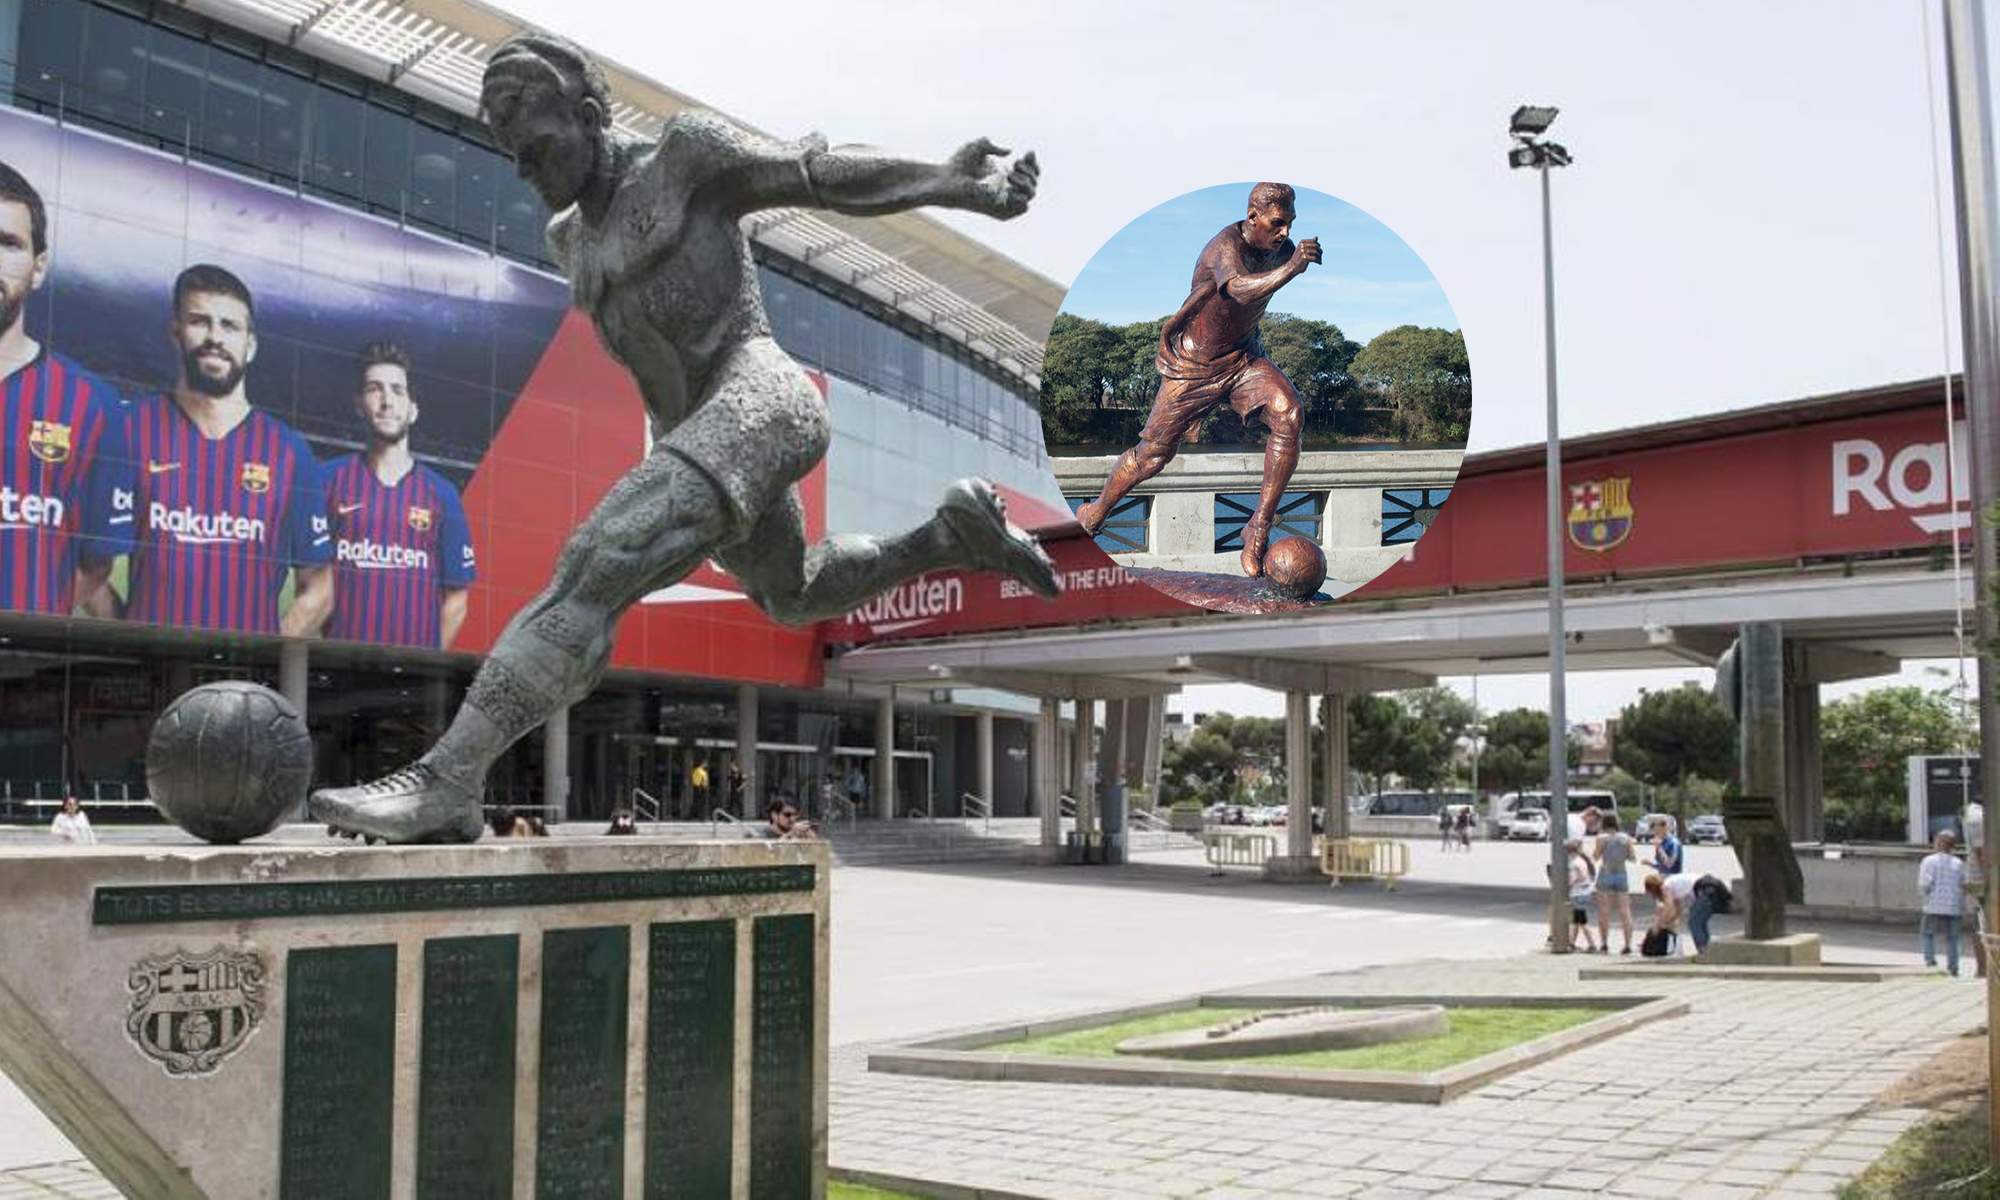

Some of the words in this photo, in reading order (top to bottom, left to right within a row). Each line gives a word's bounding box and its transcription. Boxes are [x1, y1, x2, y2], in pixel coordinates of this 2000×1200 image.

[0, 487, 63, 528] ten
[150, 502, 265, 543] Rakuten
[337, 538, 428, 569] Rakuten
[846, 574, 963, 625] akuten
[1070, 569, 1096, 591] THE
